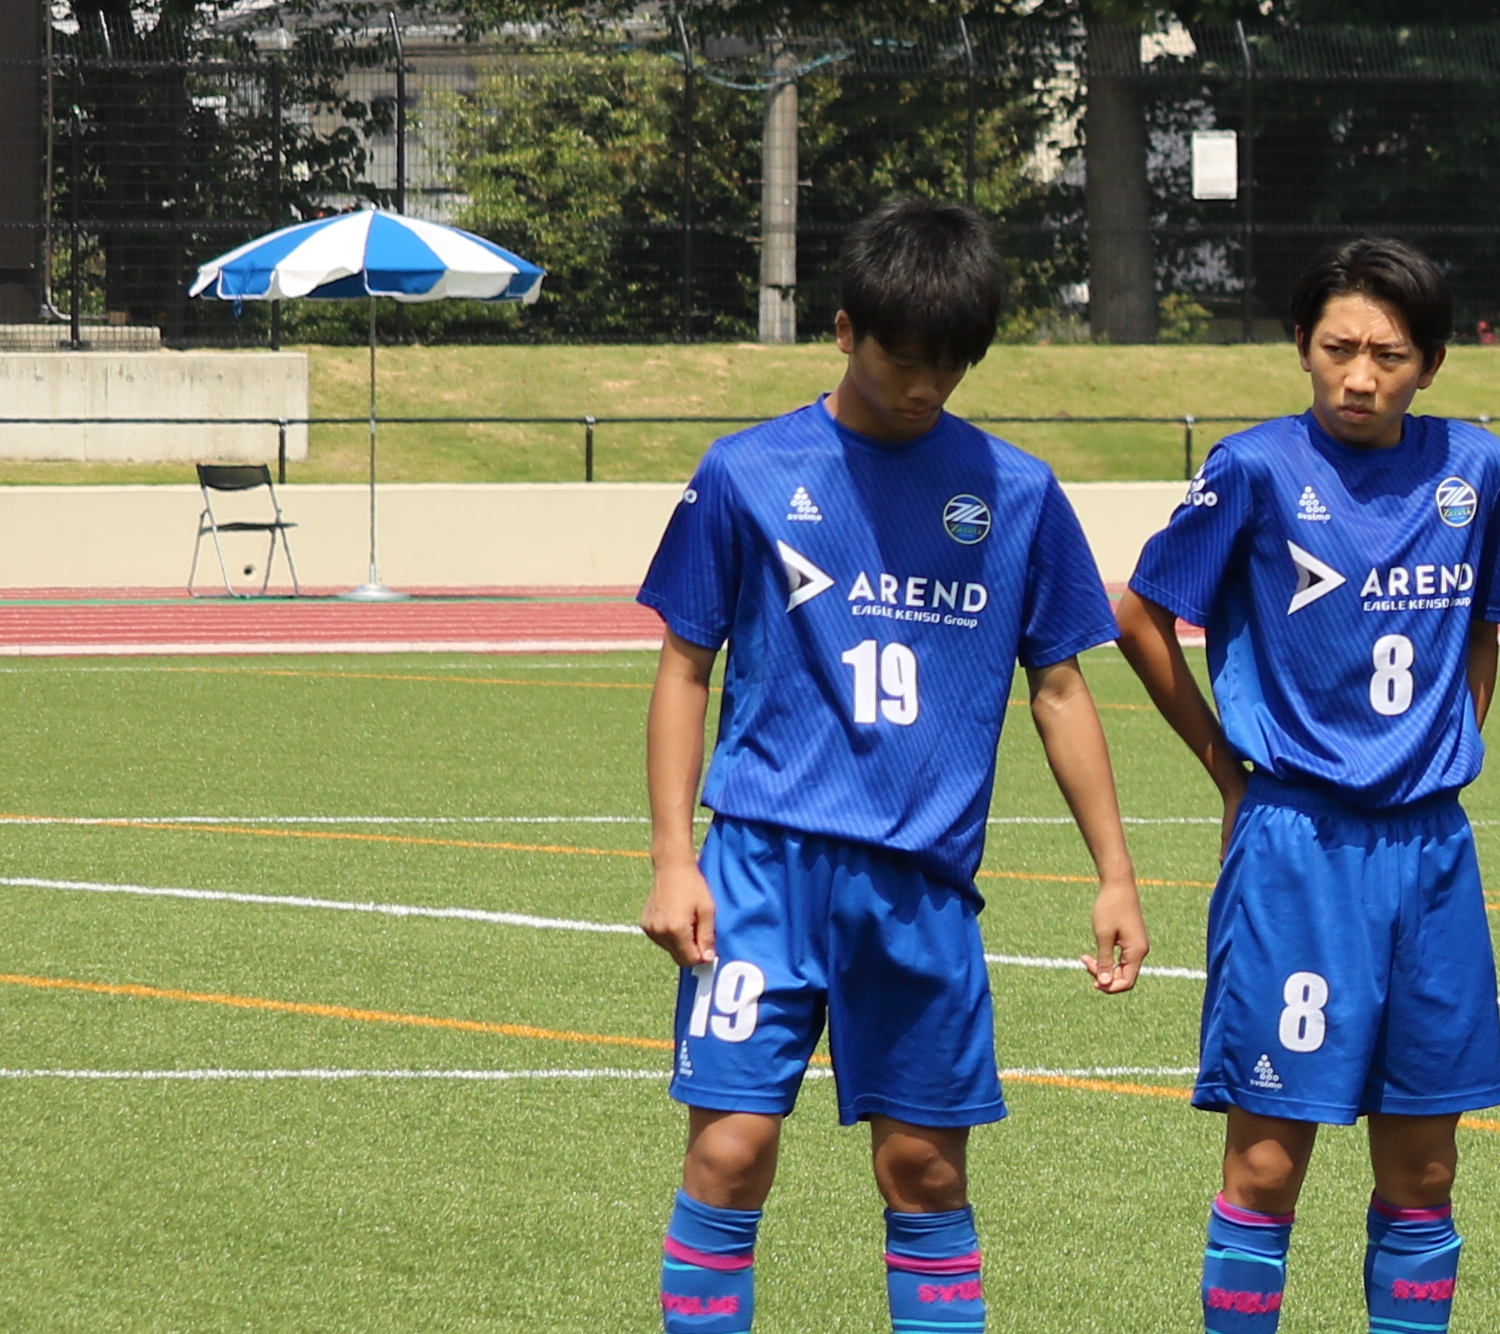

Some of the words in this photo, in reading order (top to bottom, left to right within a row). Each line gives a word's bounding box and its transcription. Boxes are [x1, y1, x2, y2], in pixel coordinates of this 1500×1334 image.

[847, 571, 988, 613] AREND
[1360, 563, 1474, 598] AREND
[1363, 599, 1407, 612] EAGLE
[1409, 597, 1449, 610] KENSO
[852, 604, 893, 618] EAGLE
[894, 609, 941, 624] KENSO
[943, 614, 978, 630] Group
[841, 639, 920, 726] 19
[1368, 633, 1415, 716] 8
[688, 957, 766, 1044] 19
[1278, 971, 1329, 1053] 8
